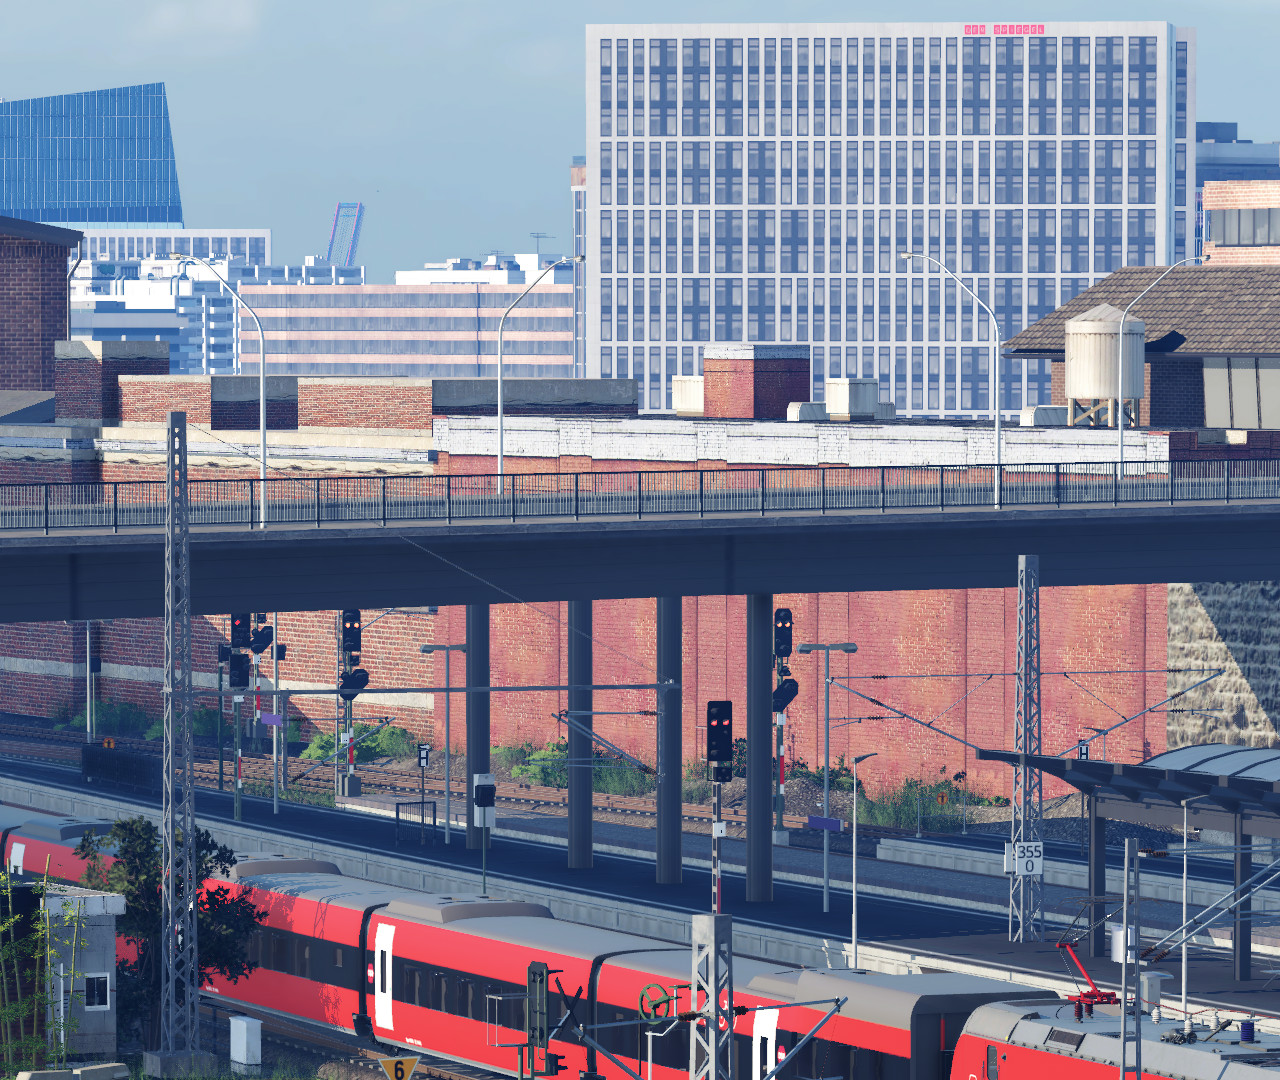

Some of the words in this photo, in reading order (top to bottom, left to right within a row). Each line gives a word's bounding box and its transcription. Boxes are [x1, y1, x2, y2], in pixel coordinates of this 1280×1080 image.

[1018, 845, 1042, 859] 355
[1025, 859, 1034, 872] 0
[394, 1060, 405, 1080] 6
